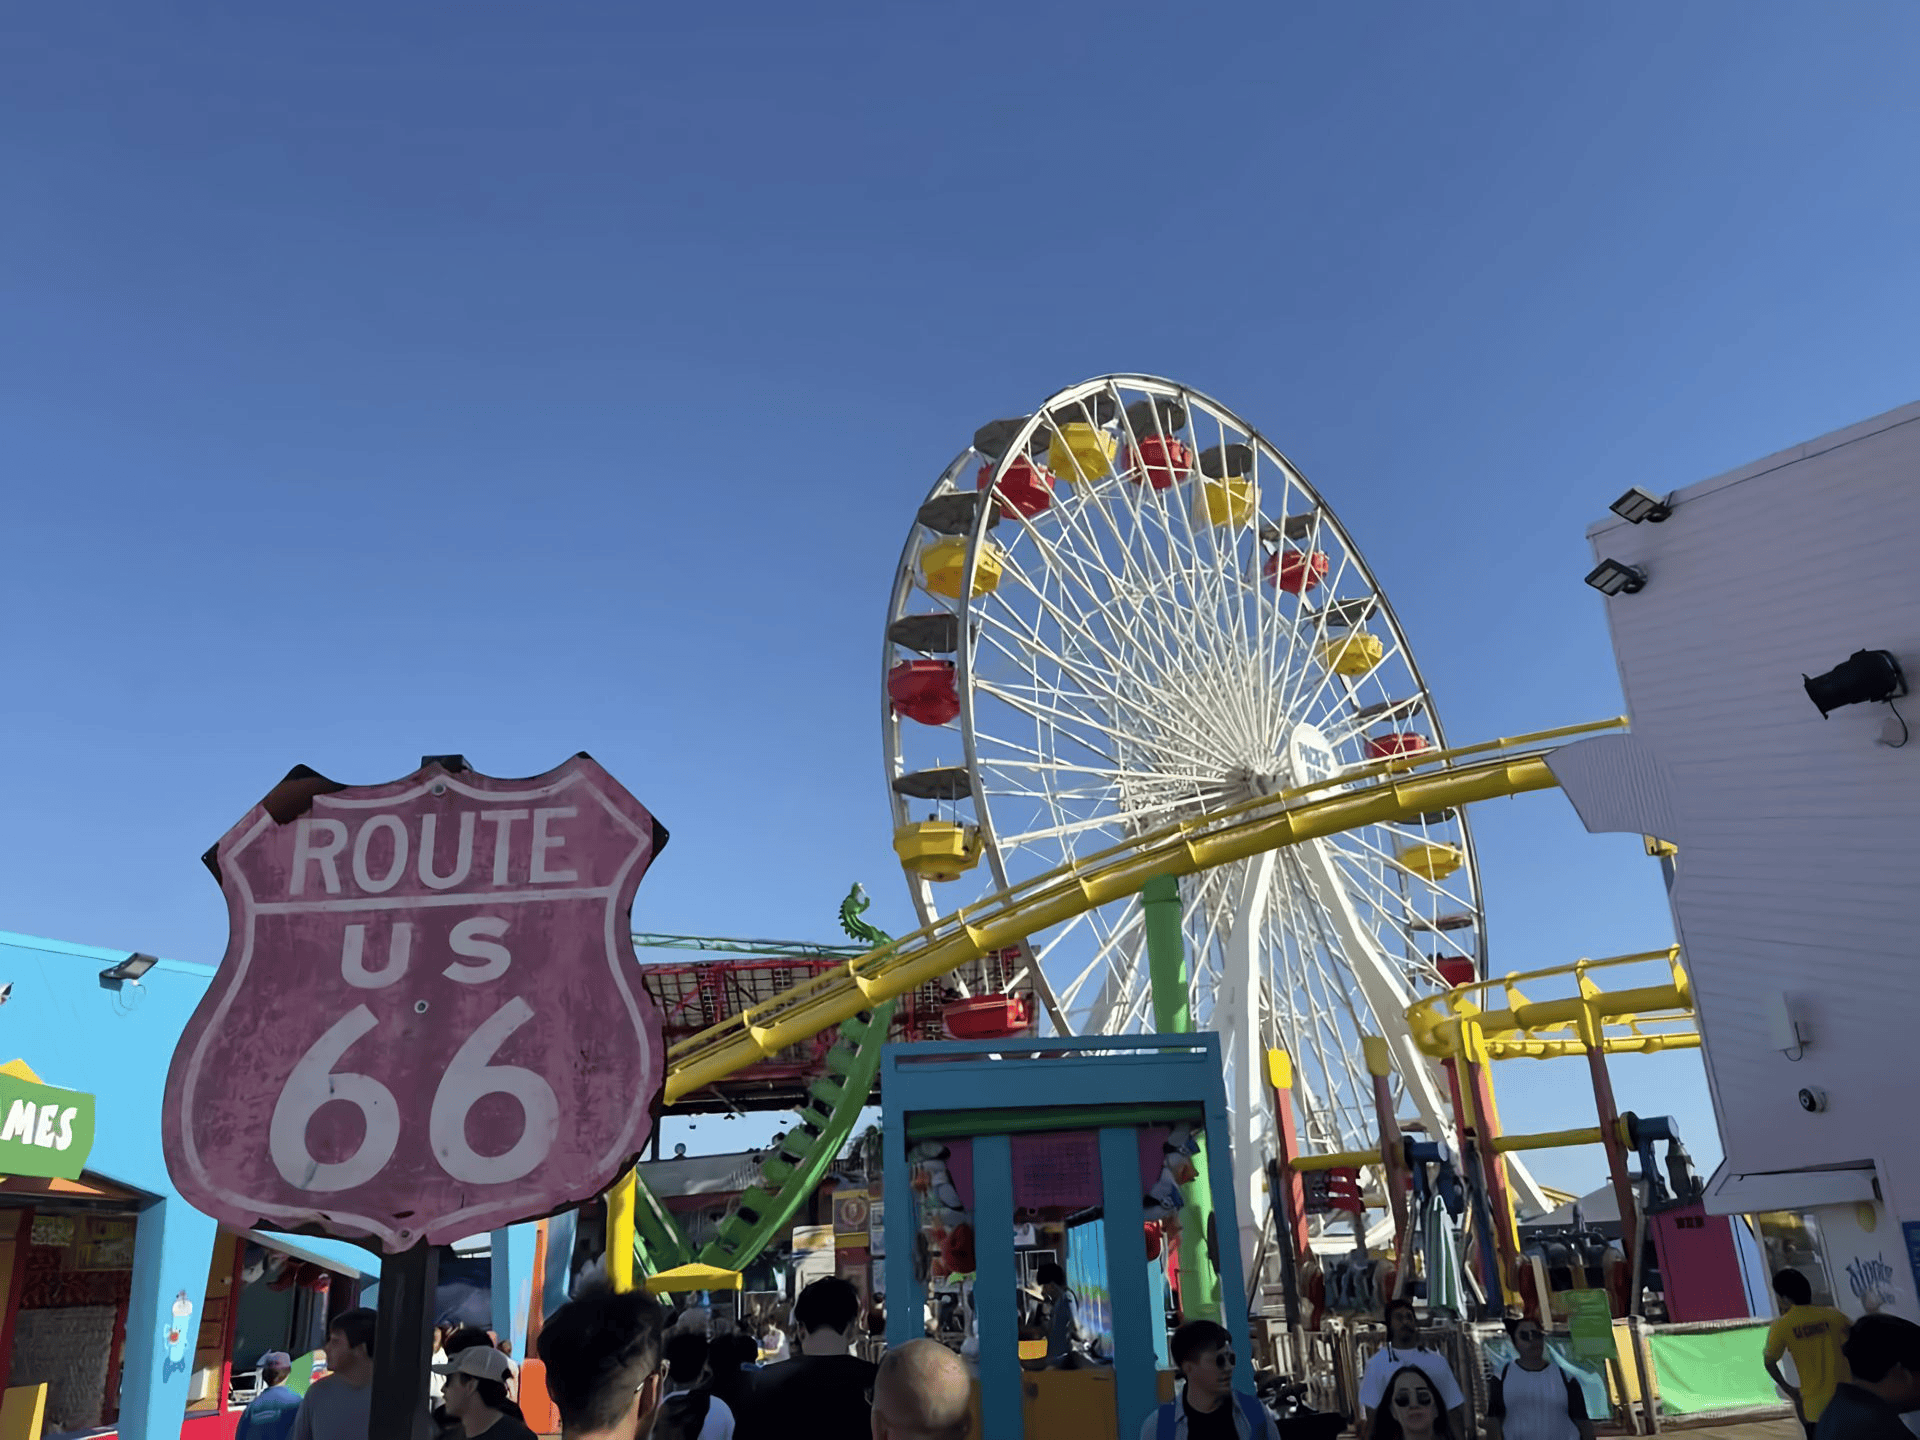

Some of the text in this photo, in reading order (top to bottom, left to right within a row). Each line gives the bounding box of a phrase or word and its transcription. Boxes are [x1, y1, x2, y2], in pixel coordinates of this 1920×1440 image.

[289, 806, 579, 896] ROUTE
[341, 916, 512, 990] US
[0, 1099, 78, 1151] MES
[269, 995, 560, 1192] 66
